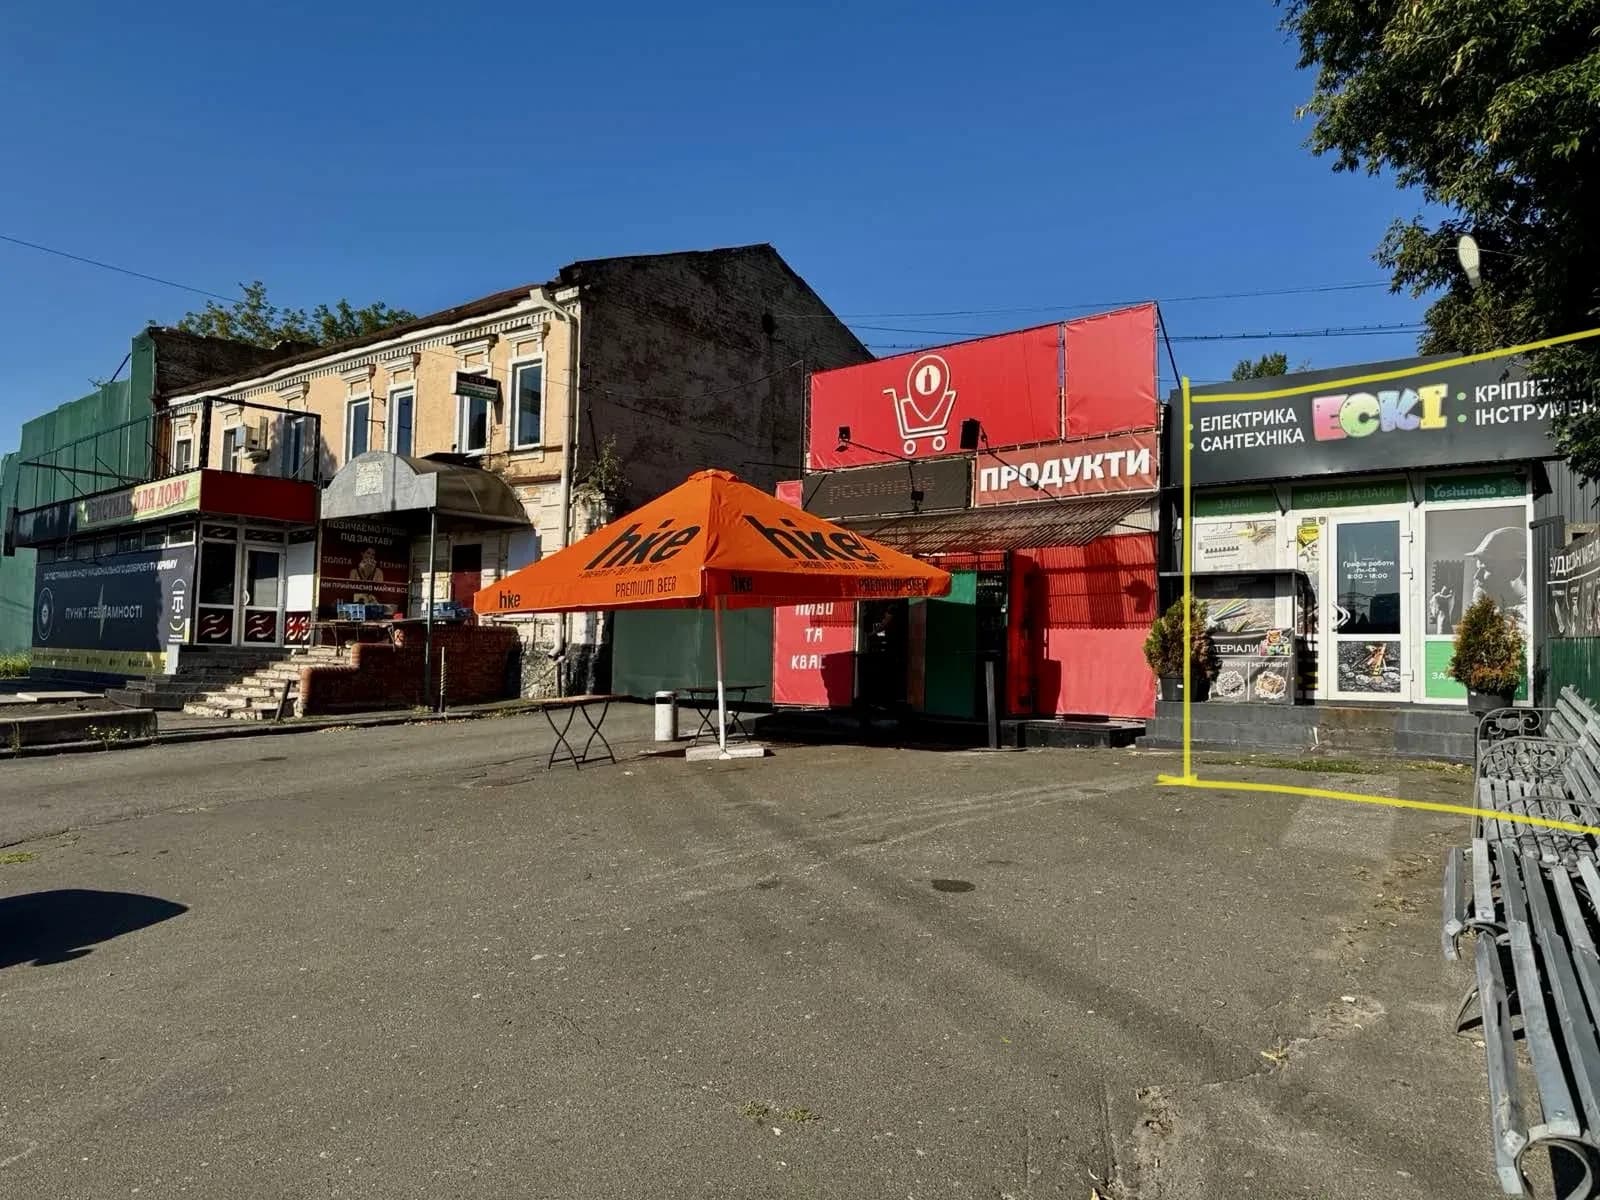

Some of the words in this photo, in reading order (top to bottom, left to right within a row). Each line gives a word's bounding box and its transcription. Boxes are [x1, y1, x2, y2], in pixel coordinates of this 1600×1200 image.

[1200, 407, 1298, 434] ЕЛЕКТРИКА
[1200, 428, 1306, 453] САНТЕХНІКА
[979, 447, 1151, 492] ПРОДУКТИ
[156, 479, 190, 509] ДОМУ
[340, 533, 356, 543] ПІД
[583, 517, 702, 571] hike
[615, 578, 654, 598] PREMIUM
[657, 575, 678, 593] BEER
[498, 590, 521, 609] hike
[65, 607, 87, 620] ПУНКТ
[804, 627, 824, 643] ТА
